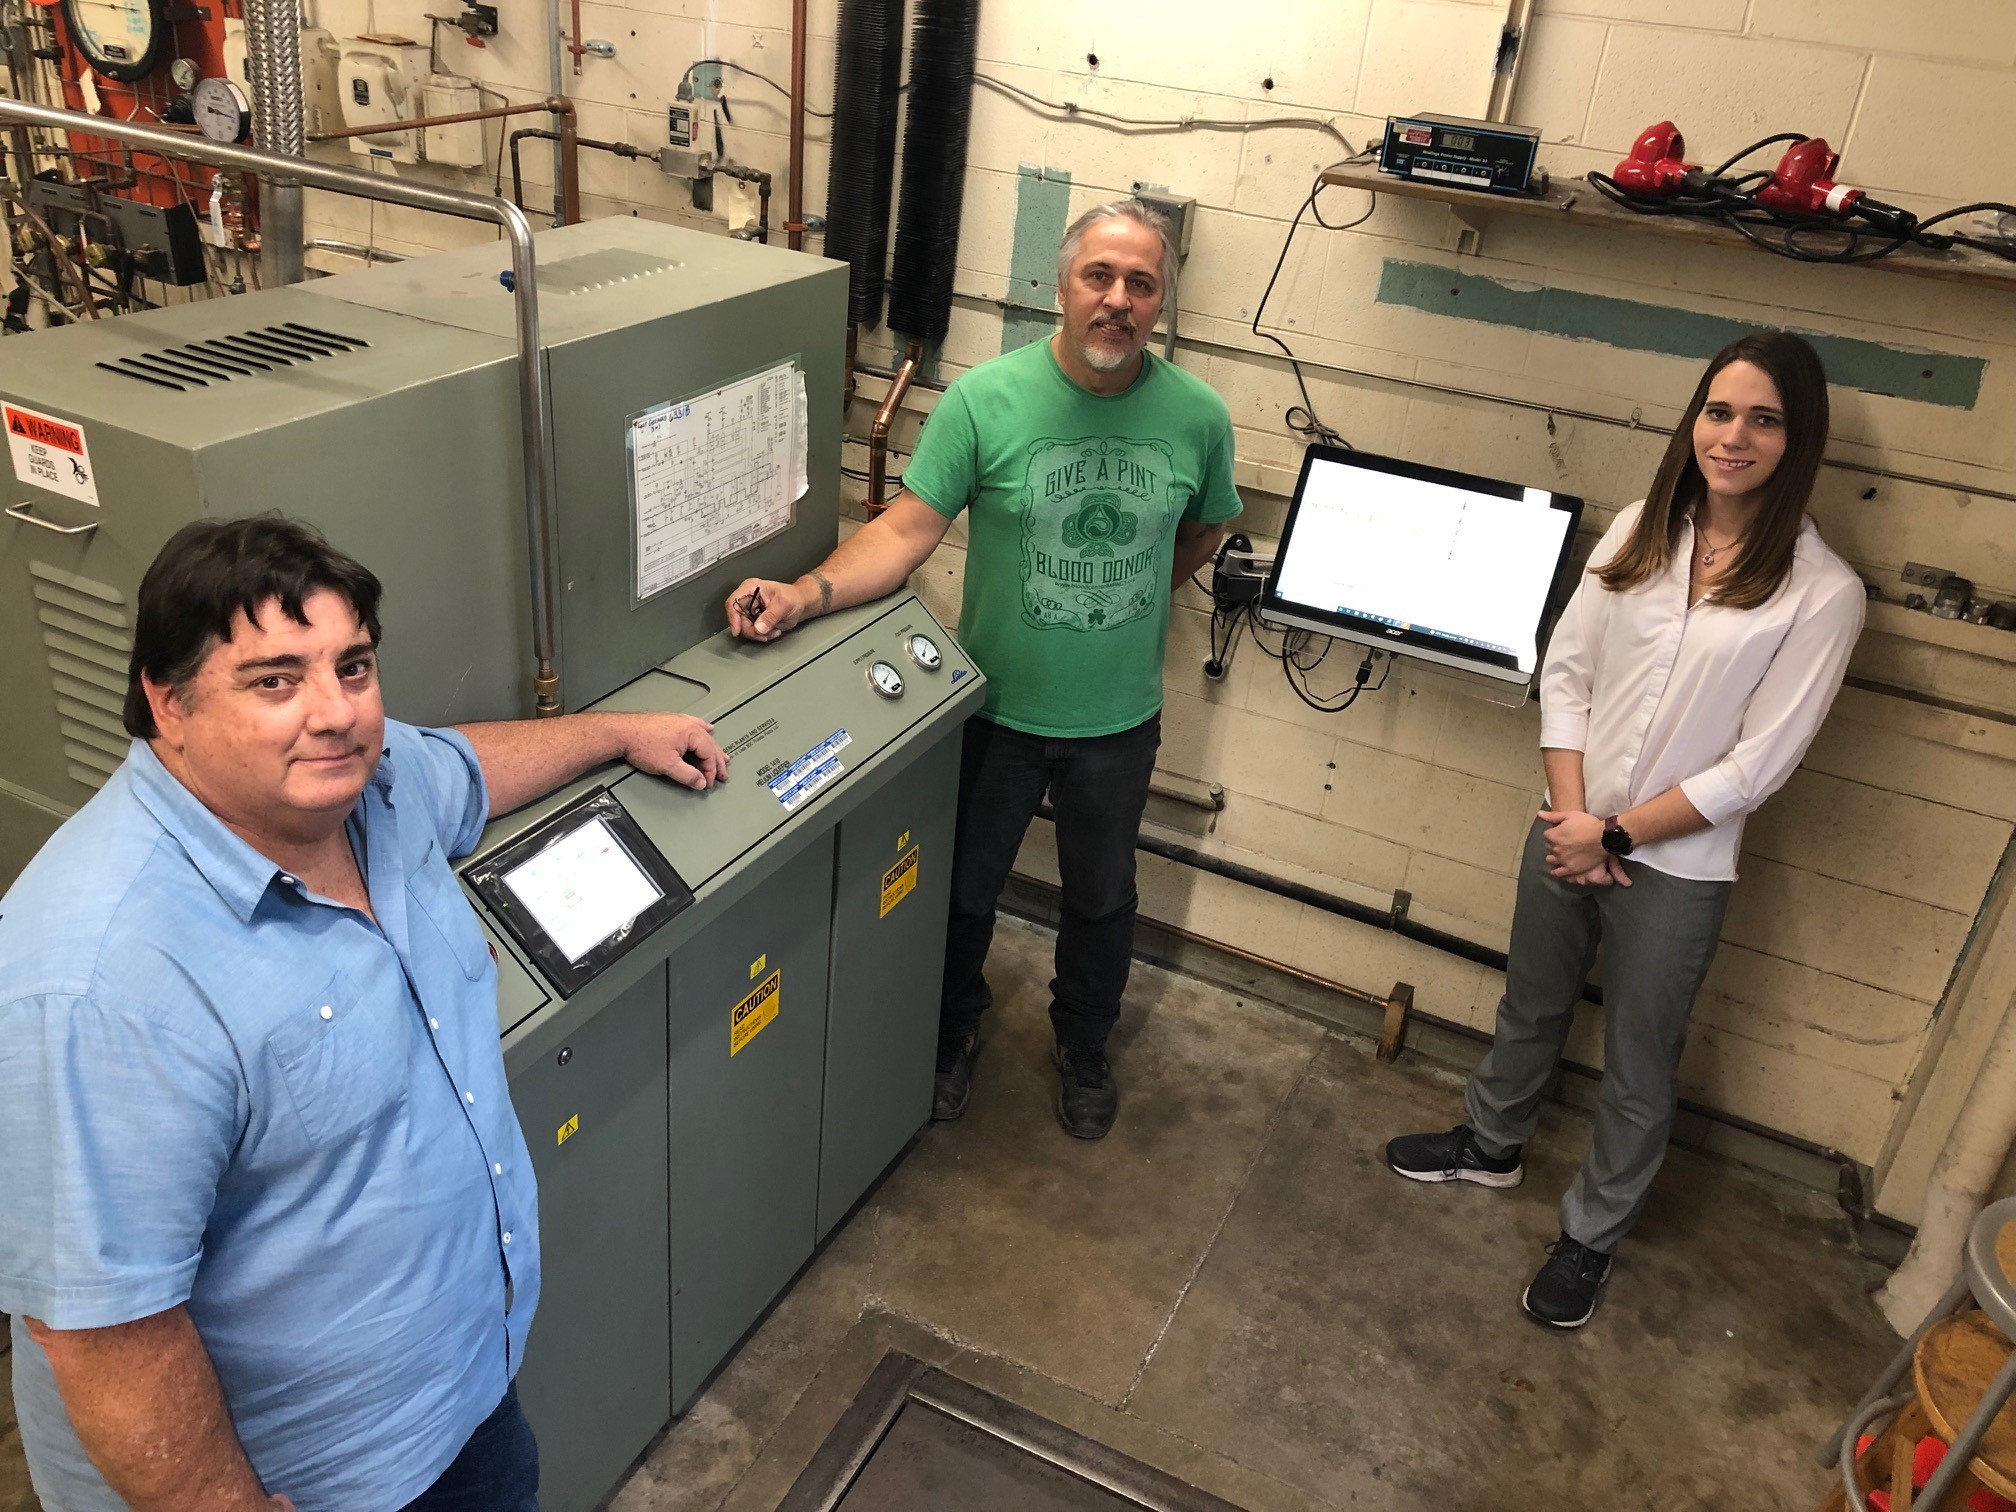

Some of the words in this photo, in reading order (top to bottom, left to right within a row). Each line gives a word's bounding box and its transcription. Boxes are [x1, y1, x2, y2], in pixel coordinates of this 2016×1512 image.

[25, 417, 80, 451] WARNING
[28, 453, 55, 471] GUARDS
[31, 444, 47, 456] KEEP
[29, 464, 37, 474] IN
[37, 467, 60, 482] PLACE
[1045, 459, 1087, 498] GIVE
[1096, 457, 1109, 481] A
[1118, 458, 1158, 495] PINT
[1036, 550, 1093, 584] BLOOD
[1102, 546, 1155, 583] DONOR
[734, 734, 750, 745] PLANTS
[757, 717, 775, 730] SERVICES
[756, 764, 772, 777] MODEL
[756, 772, 772, 787] HELIUM
[885, 850, 917, 888] CAUTION
[735, 978, 777, 1023] CAUTION
